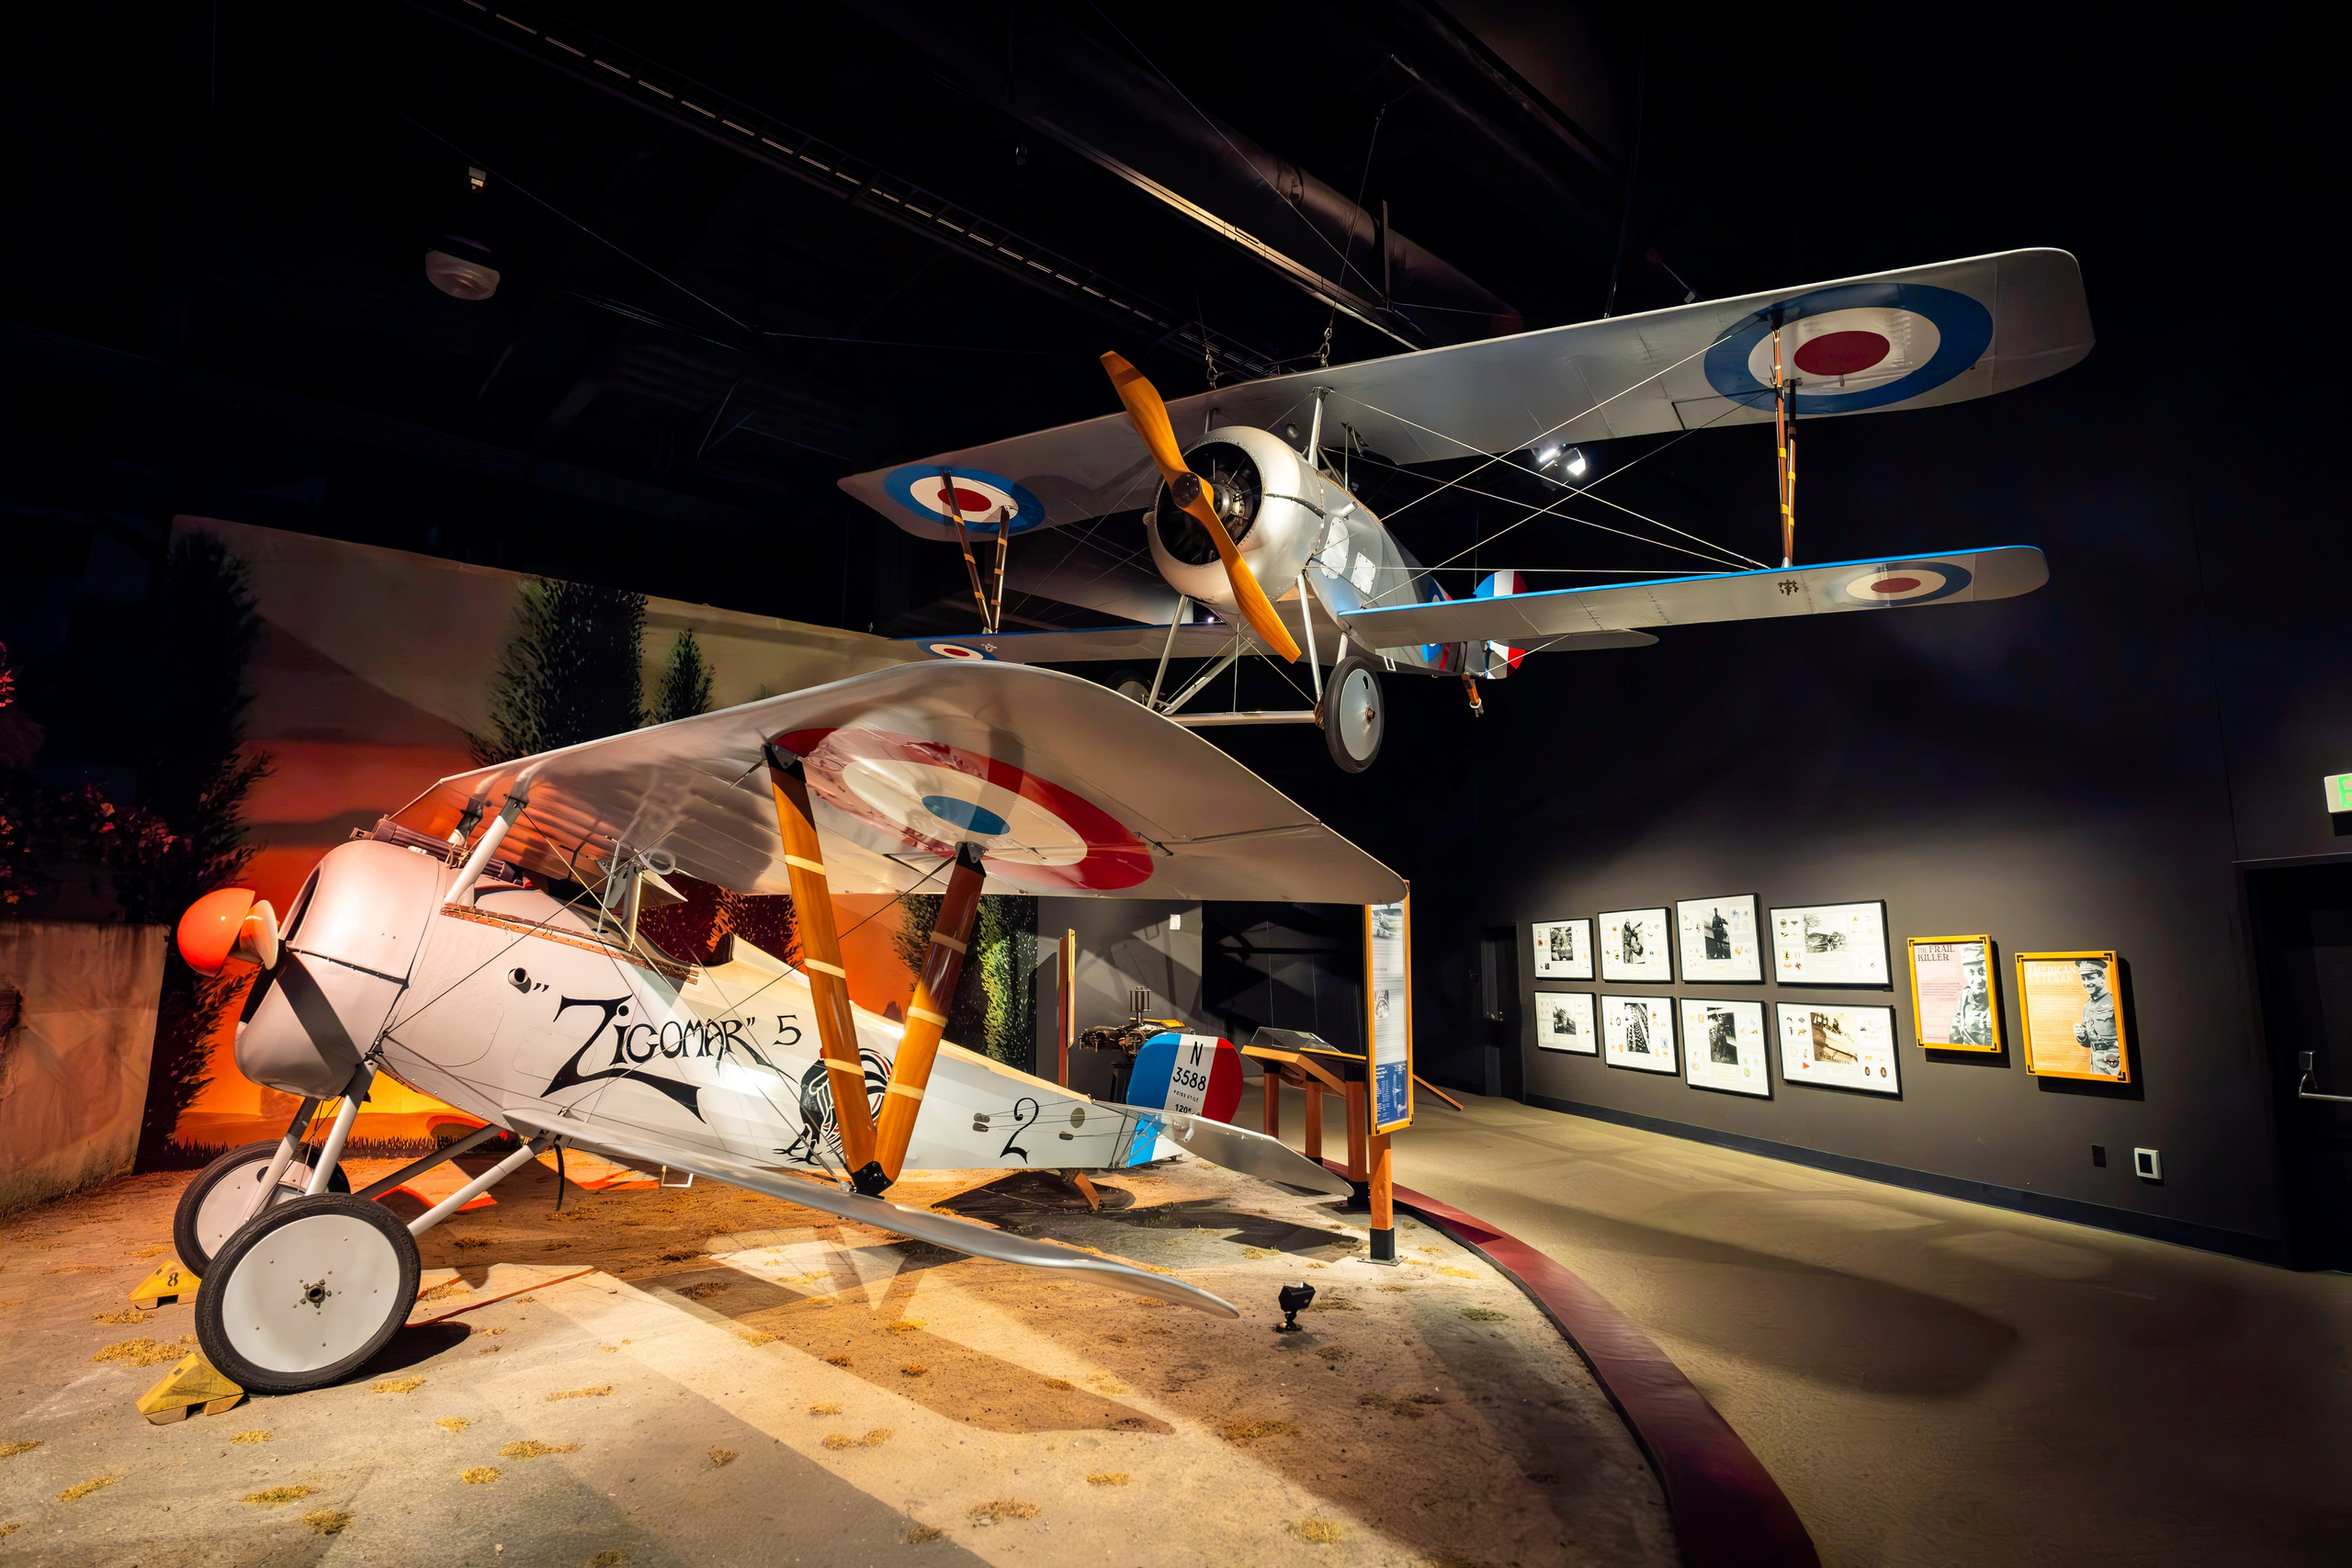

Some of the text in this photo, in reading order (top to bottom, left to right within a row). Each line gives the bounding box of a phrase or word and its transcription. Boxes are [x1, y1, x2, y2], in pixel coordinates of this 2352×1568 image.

[1928, 944, 1955, 953] FRAIL
[1917, 953, 1950, 962] KILLER
[2027, 973, 2074, 983] VETERAN
[2028, 965, 2076, 975] AMERICAN
[772, 1014, 802, 1046] 5
[1190, 1041, 1204, 1066] N
[1172, 1066, 1206, 1091] 3588
[1000, 1097, 1039, 1164] 2
[167, 1271, 179, 1287] 8
